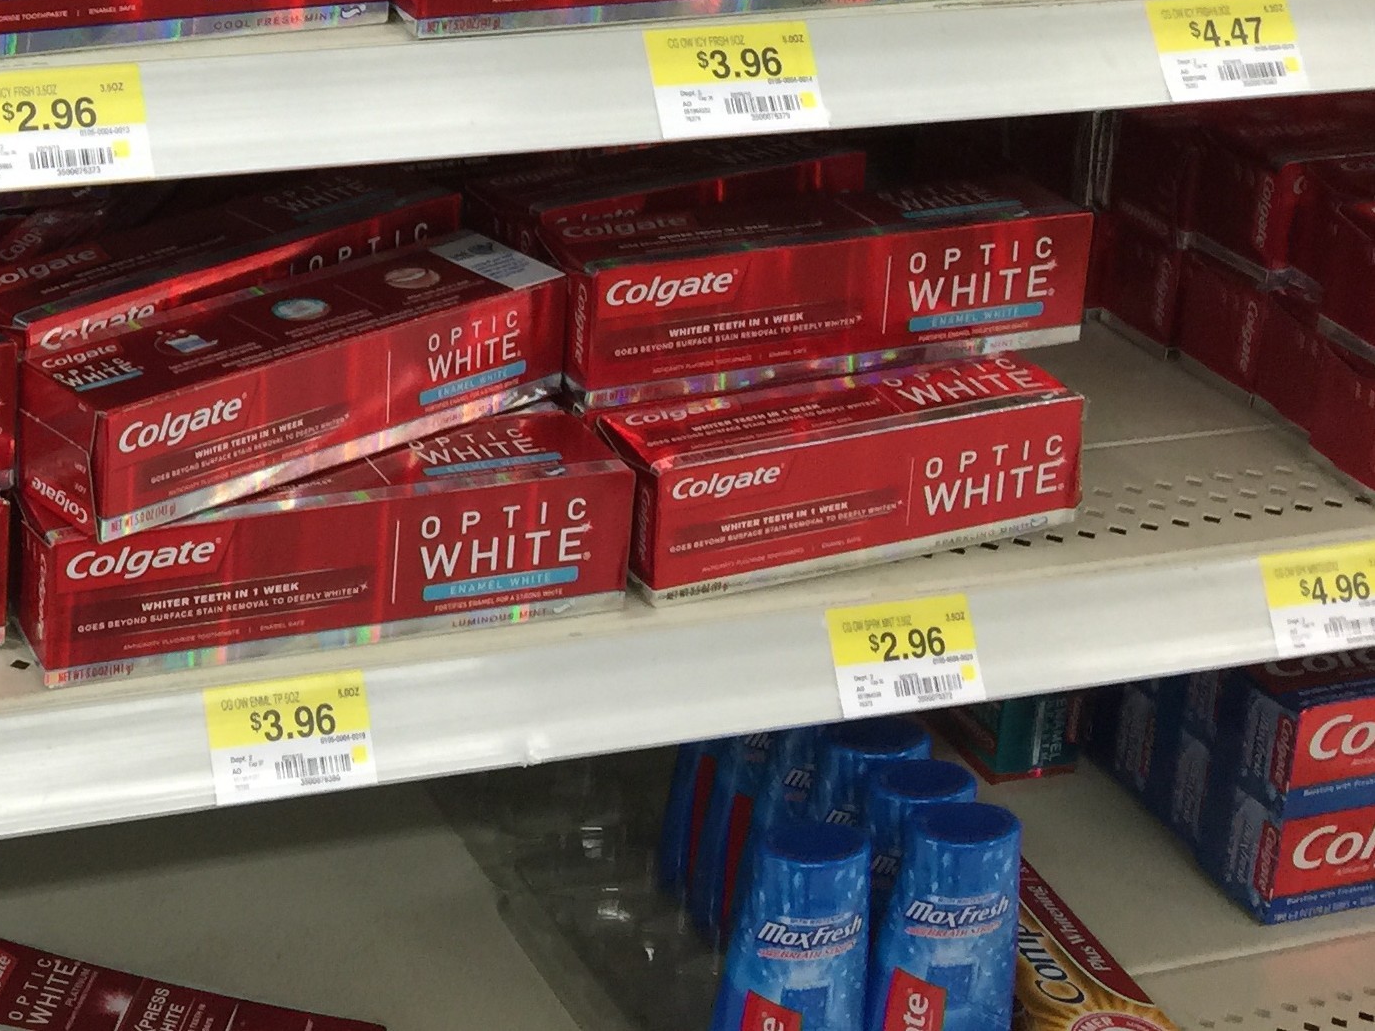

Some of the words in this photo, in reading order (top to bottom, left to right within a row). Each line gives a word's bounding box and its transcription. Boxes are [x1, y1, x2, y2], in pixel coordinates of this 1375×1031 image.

[1189, 15, 1264, 48] $4.47
[697, 46, 783, 84] $3.96
[2, 96, 97, 132] $2.96
[604, 270, 734, 307] Colgate
[907, 264, 1047, 312] WHITE
[118, 394, 243, 456] Colgate
[671, 465, 782, 503] Colgate
[923, 461, 1059, 516] WHITE
[421, 496, 589, 541] OPTIC
[419, 526, 586, 581] WHITE
[1299, 572, 1370, 605] $4.96
[869, 626, 946, 663] $2.96
[250, 702, 337, 743] $3.96
[906, 895, 1010, 929] MaxFresh
